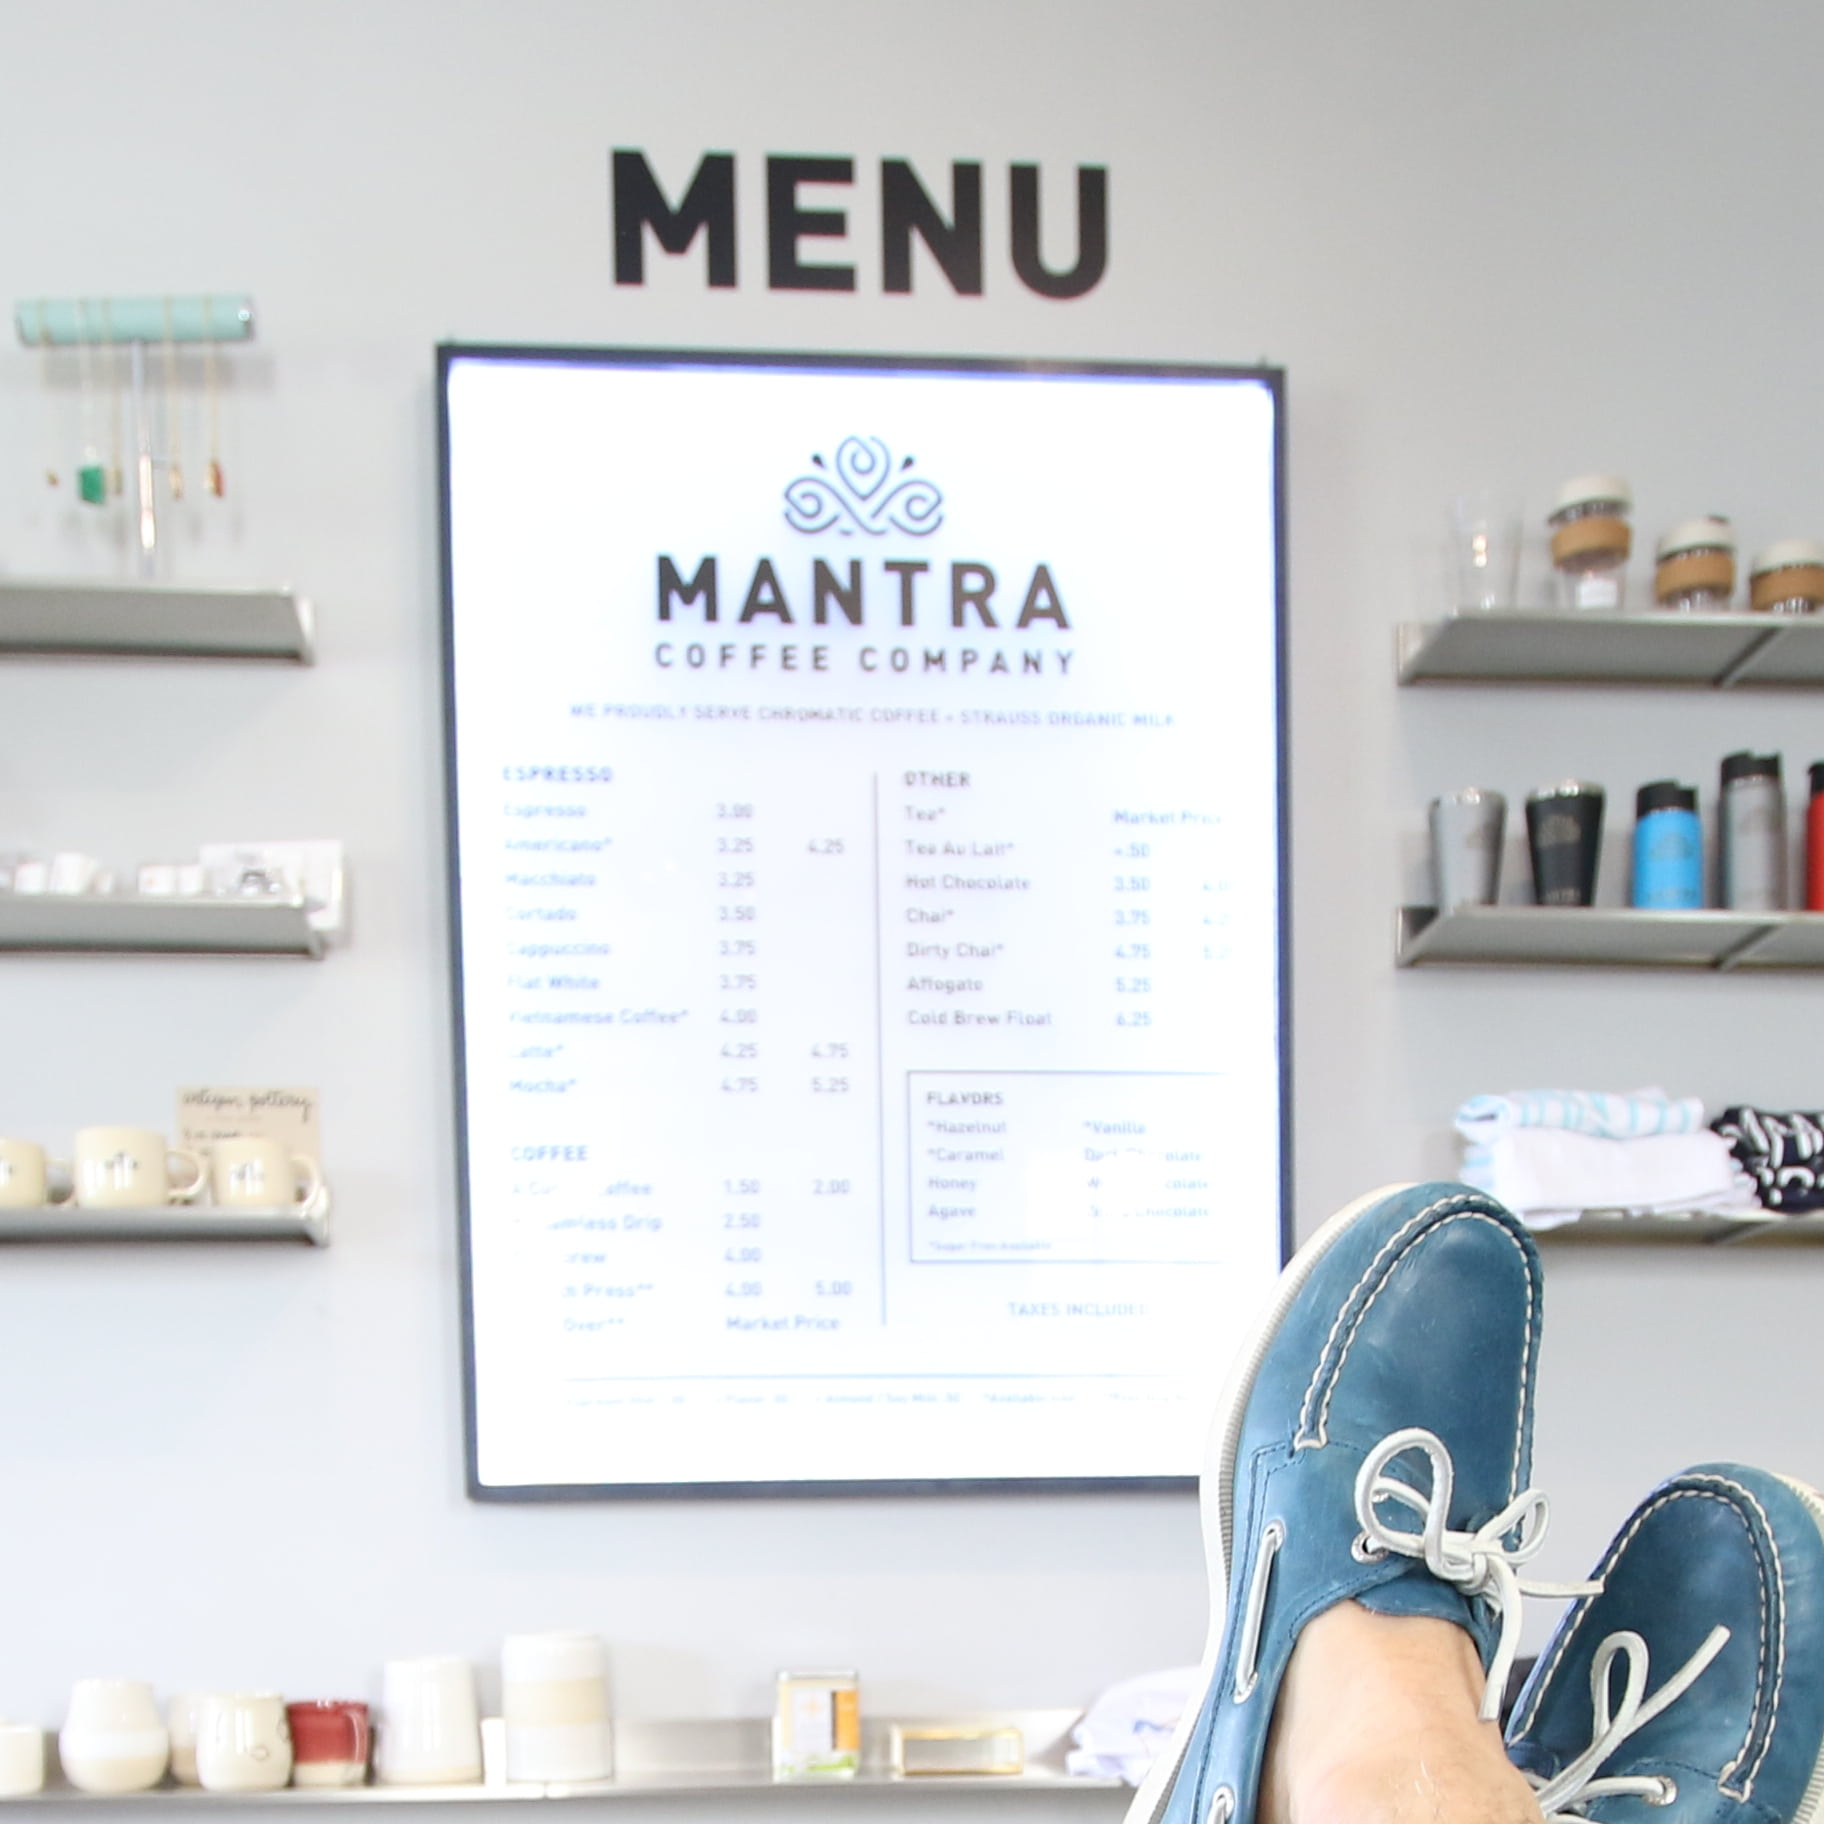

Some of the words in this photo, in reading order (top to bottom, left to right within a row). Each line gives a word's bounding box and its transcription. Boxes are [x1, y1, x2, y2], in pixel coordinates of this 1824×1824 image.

[612, 148, 1109, 300] MENU
[657, 555, 1070, 630] MANTRA
[655, 643, 831, 672] COFFEE
[859, 645, 1074, 675] COMPANY
[571, 705, 594, 718] WE
[604, 704, 686, 719] PROUDLY
[695, 705, 751, 720] SERVE
[758, 707, 863, 722] CHROMATIC
[871, 708, 938, 723] COFFEE
[961, 709, 1042, 725] STRAUSS
[1049, 711, 1125, 726] ORGANIC
[503, 766, 612, 782] ESPRESSO
[904, 771, 971, 788] OTHER
[1113, 810, 1174, 825] Market
[717, 837, 754, 852] 3.25
[808, 839, 844, 854] 4.25
[904, 841, 938, 856] Tea
[718, 872, 754, 888] 3.25
[905, 875, 938, 891] Hot
[942, 875, 1031, 891] Chocolate
[1114, 877, 1150, 892] 3.50
[719, 906, 755, 922] 3.50
[906, 942, 950, 960] Dirty
[906, 978, 983, 995] Affogato
[1116, 978, 1151, 993] 5.25
[907, 1011, 947, 1026] Cold
[954, 1011, 1000, 1026] Brew
[1006, 1011, 1052, 1026] Float
[721, 1043, 757, 1059] 4.25
[811, 1077, 849, 1093] 5.25
[927, 1091, 1003, 1106] FLAVORS
[511, 1146, 589, 1162] COFFEE
[599, 1182, 652, 1196] offee
[928, 1176, 976, 1194] Honey
[928, 1204, 975, 1221] Agave
[1008, 1301, 1060, 1317] TAXES
[726, 1316, 787, 1330] Market
[794, 1315, 840, 1330] Price
